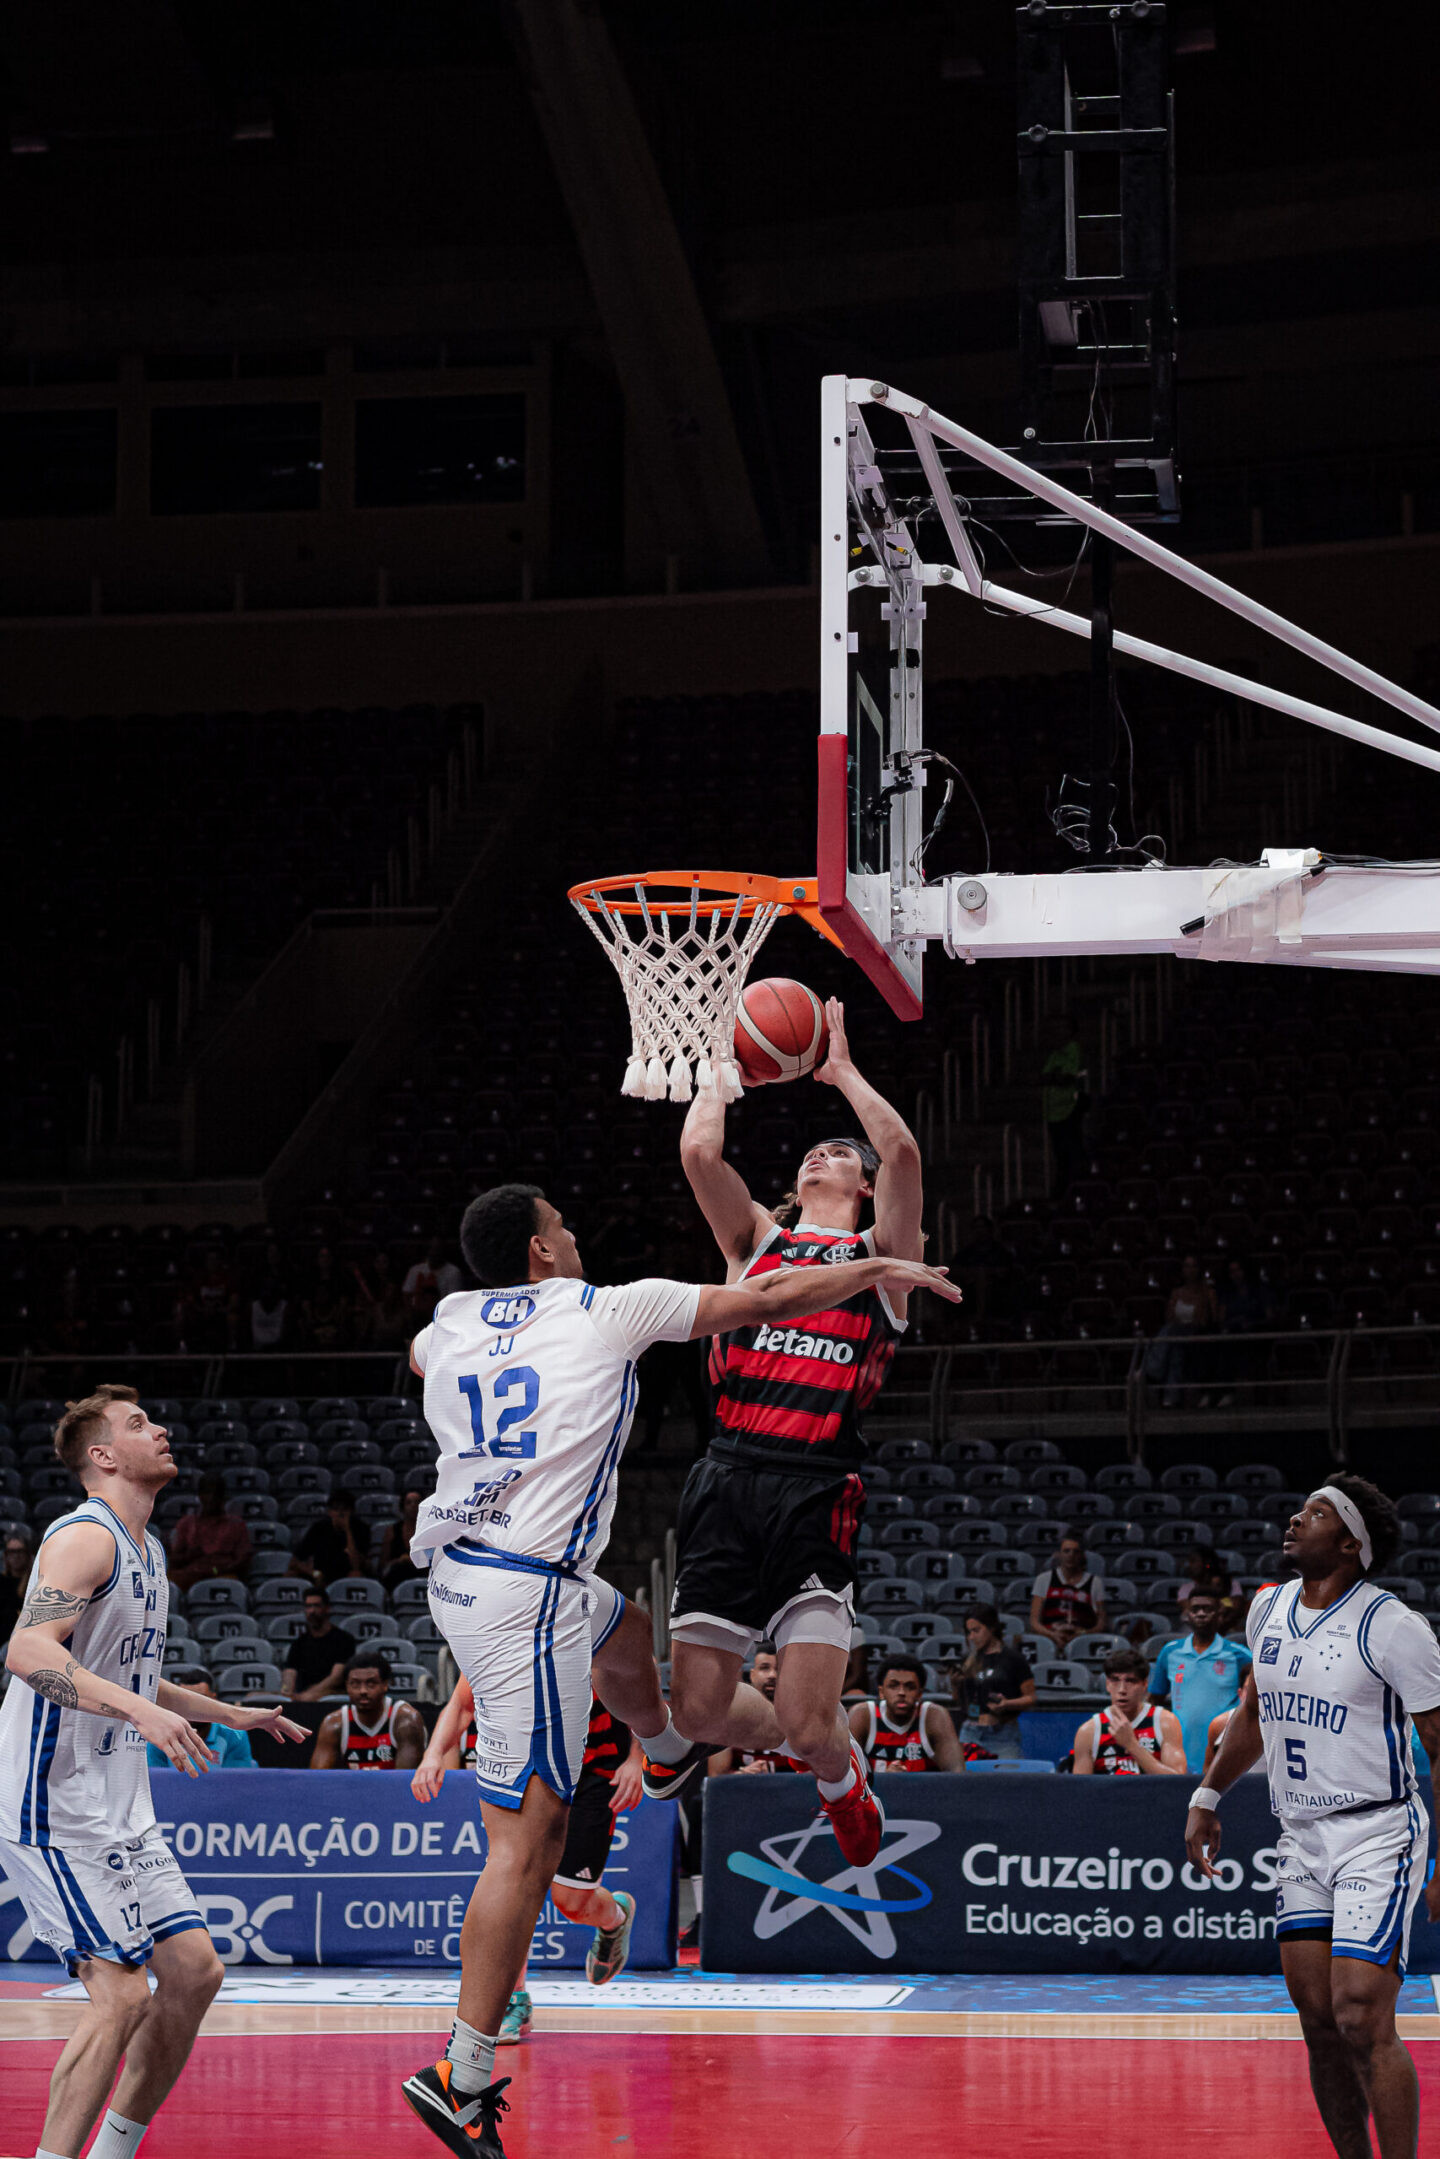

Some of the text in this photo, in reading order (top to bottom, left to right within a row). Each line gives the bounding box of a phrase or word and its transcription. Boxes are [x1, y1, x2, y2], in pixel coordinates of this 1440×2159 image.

[487, 1299, 530, 1323] BH
[488, 1335, 515, 1357] JJ
[458, 1365, 541, 1460] 12
[1258, 1691, 1348, 1735] CRUZEIRO
[1284, 1738, 1308, 1781] 5
[1285, 1790, 1356, 1808] ITATIAIUÇU
[391, 1822, 444, 1856] DE
[961, 1843, 1174, 1892] Cruzeiro
[1180, 1845, 1244, 1892] do
[120, 1901, 142, 1932] 17
[344, 1894, 466, 1930] COMITÊ
[965, 1904, 1278, 1945] Educação a distân
[414, 1939, 437, 1956] DE
